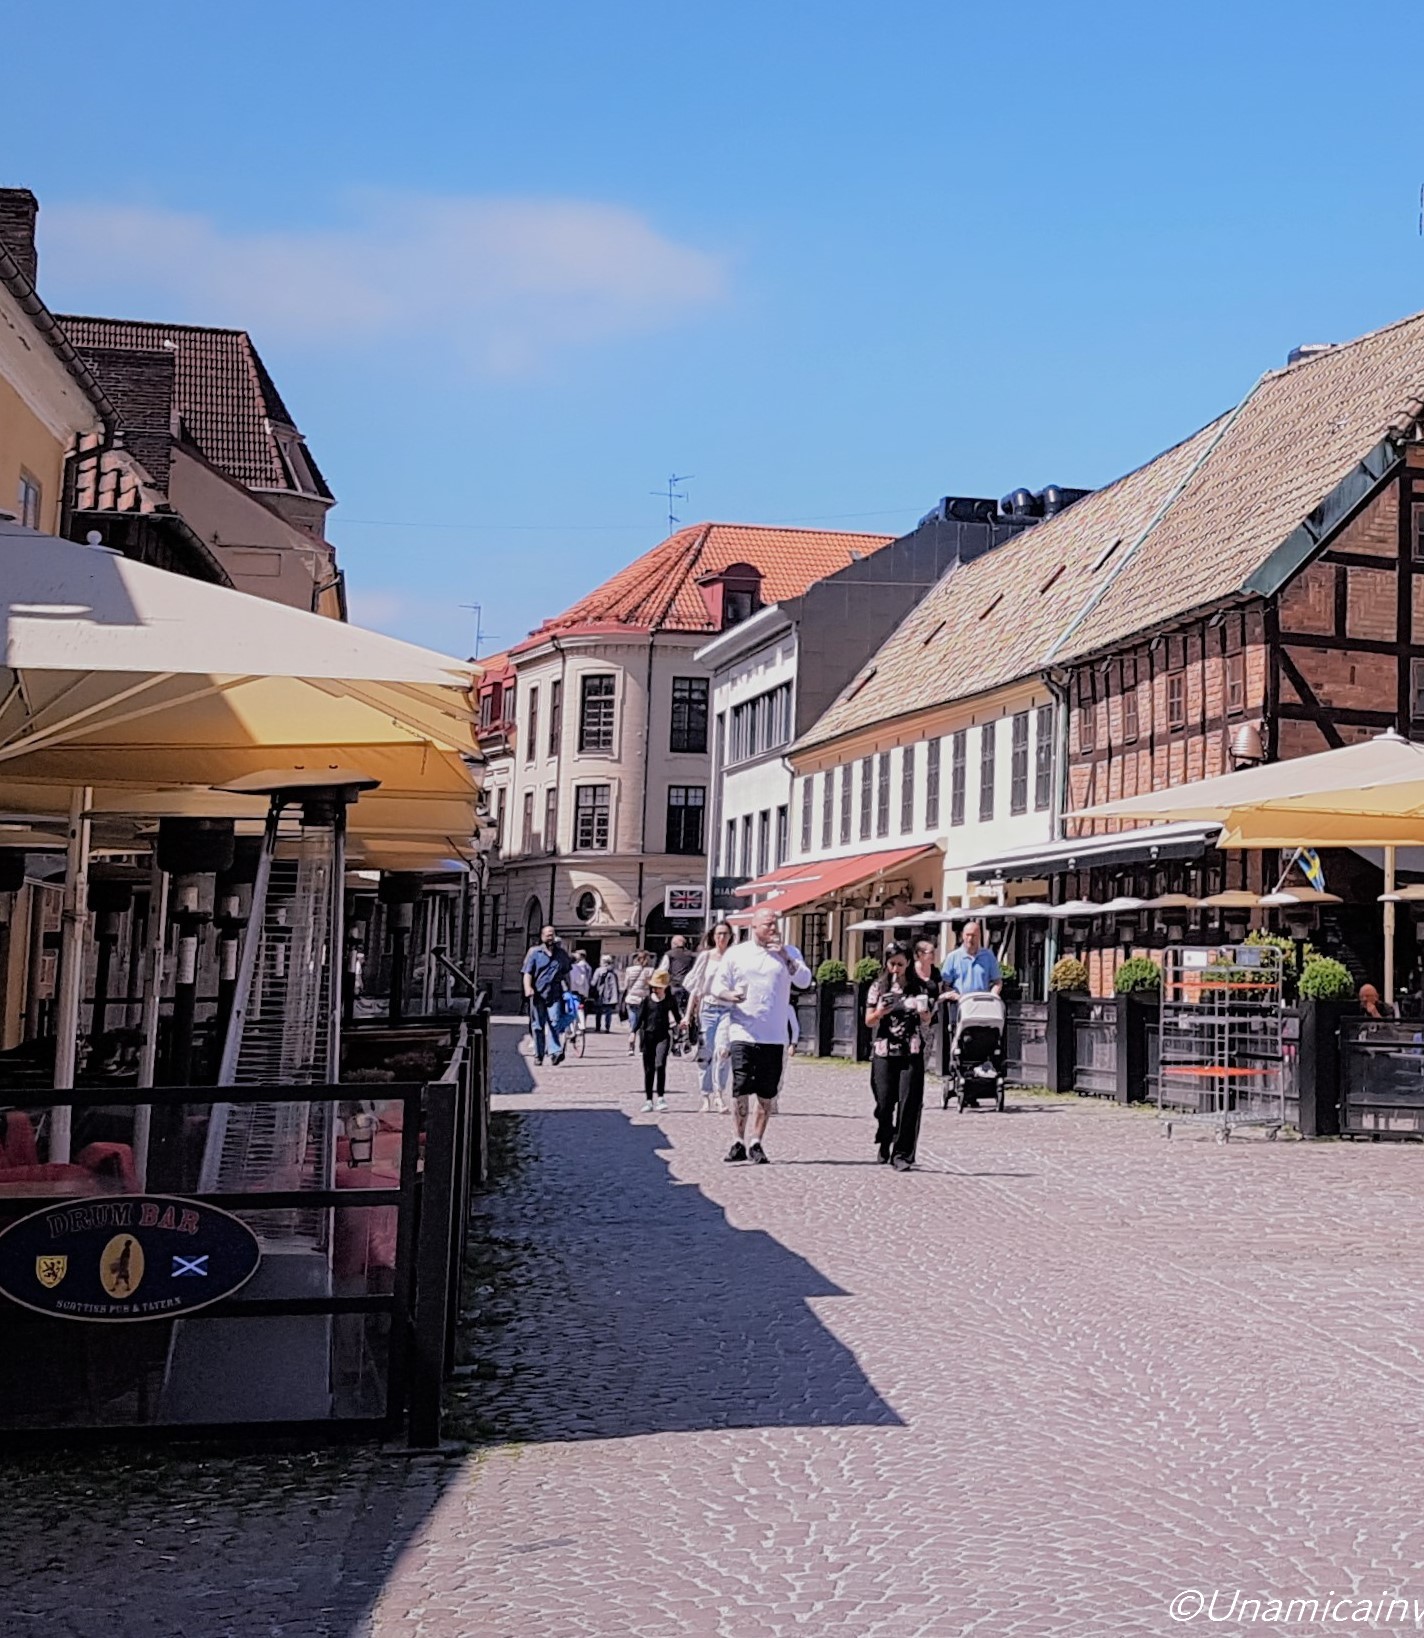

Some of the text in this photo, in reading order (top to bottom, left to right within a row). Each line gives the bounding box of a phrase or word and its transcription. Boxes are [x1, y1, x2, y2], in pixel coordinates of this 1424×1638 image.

[46, 1203, 200, 1239] DRUM BAR
[55, 1296, 182, 1314] SCOTTISH PUB & TAVERN
